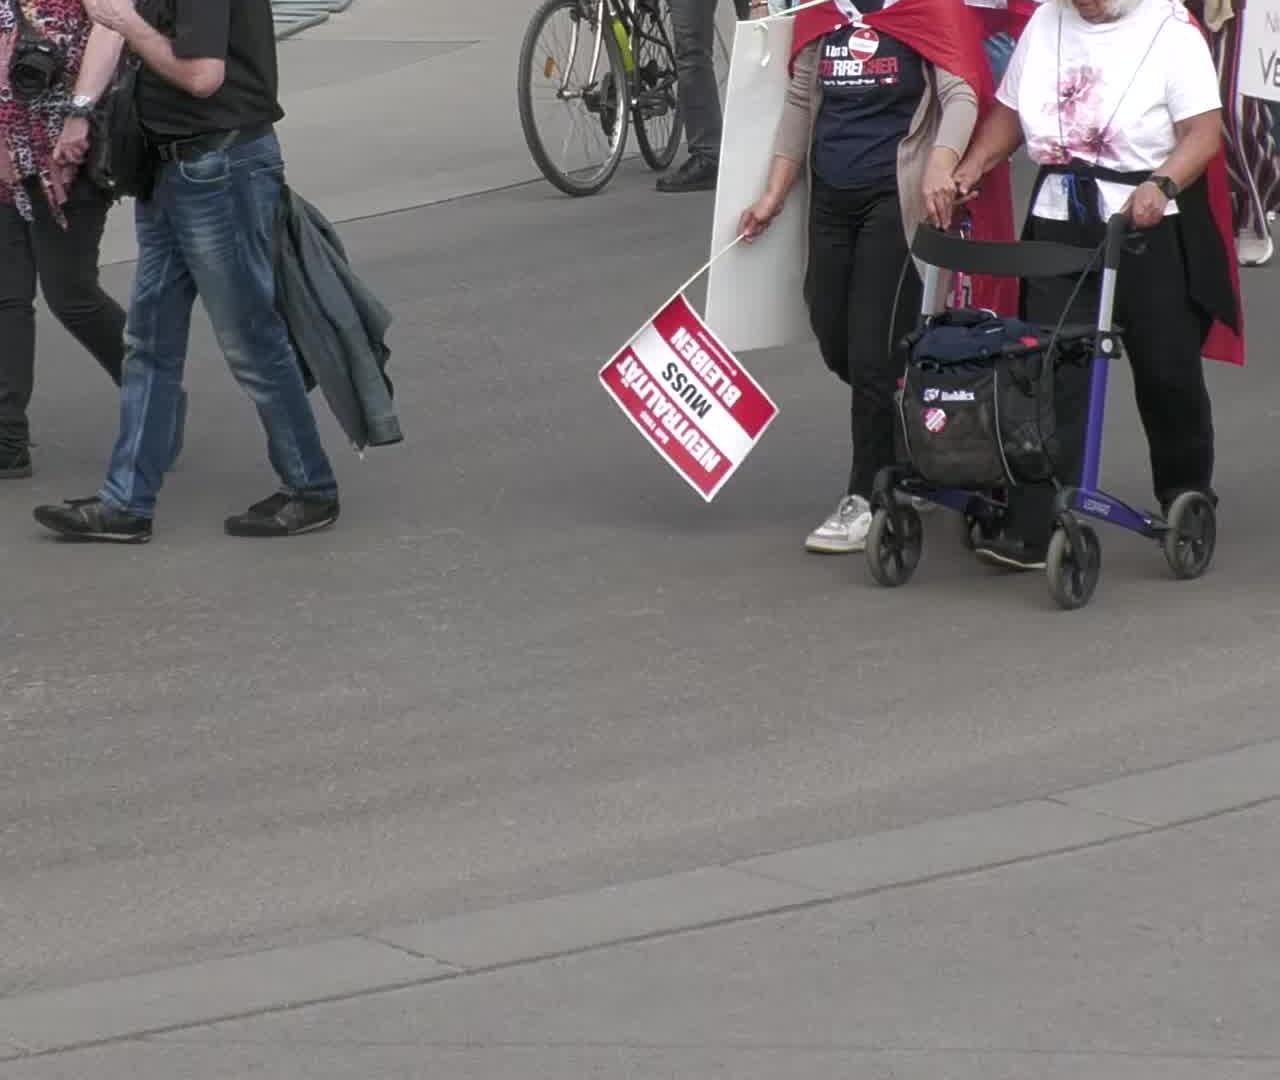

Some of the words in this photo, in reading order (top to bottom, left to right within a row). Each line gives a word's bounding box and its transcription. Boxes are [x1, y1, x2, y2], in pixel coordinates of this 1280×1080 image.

[661, 362, 712, 419] MUSS
[670, 326, 742, 409] BLEIBEN
[616, 355, 722, 473] NEUTRALITÄT
